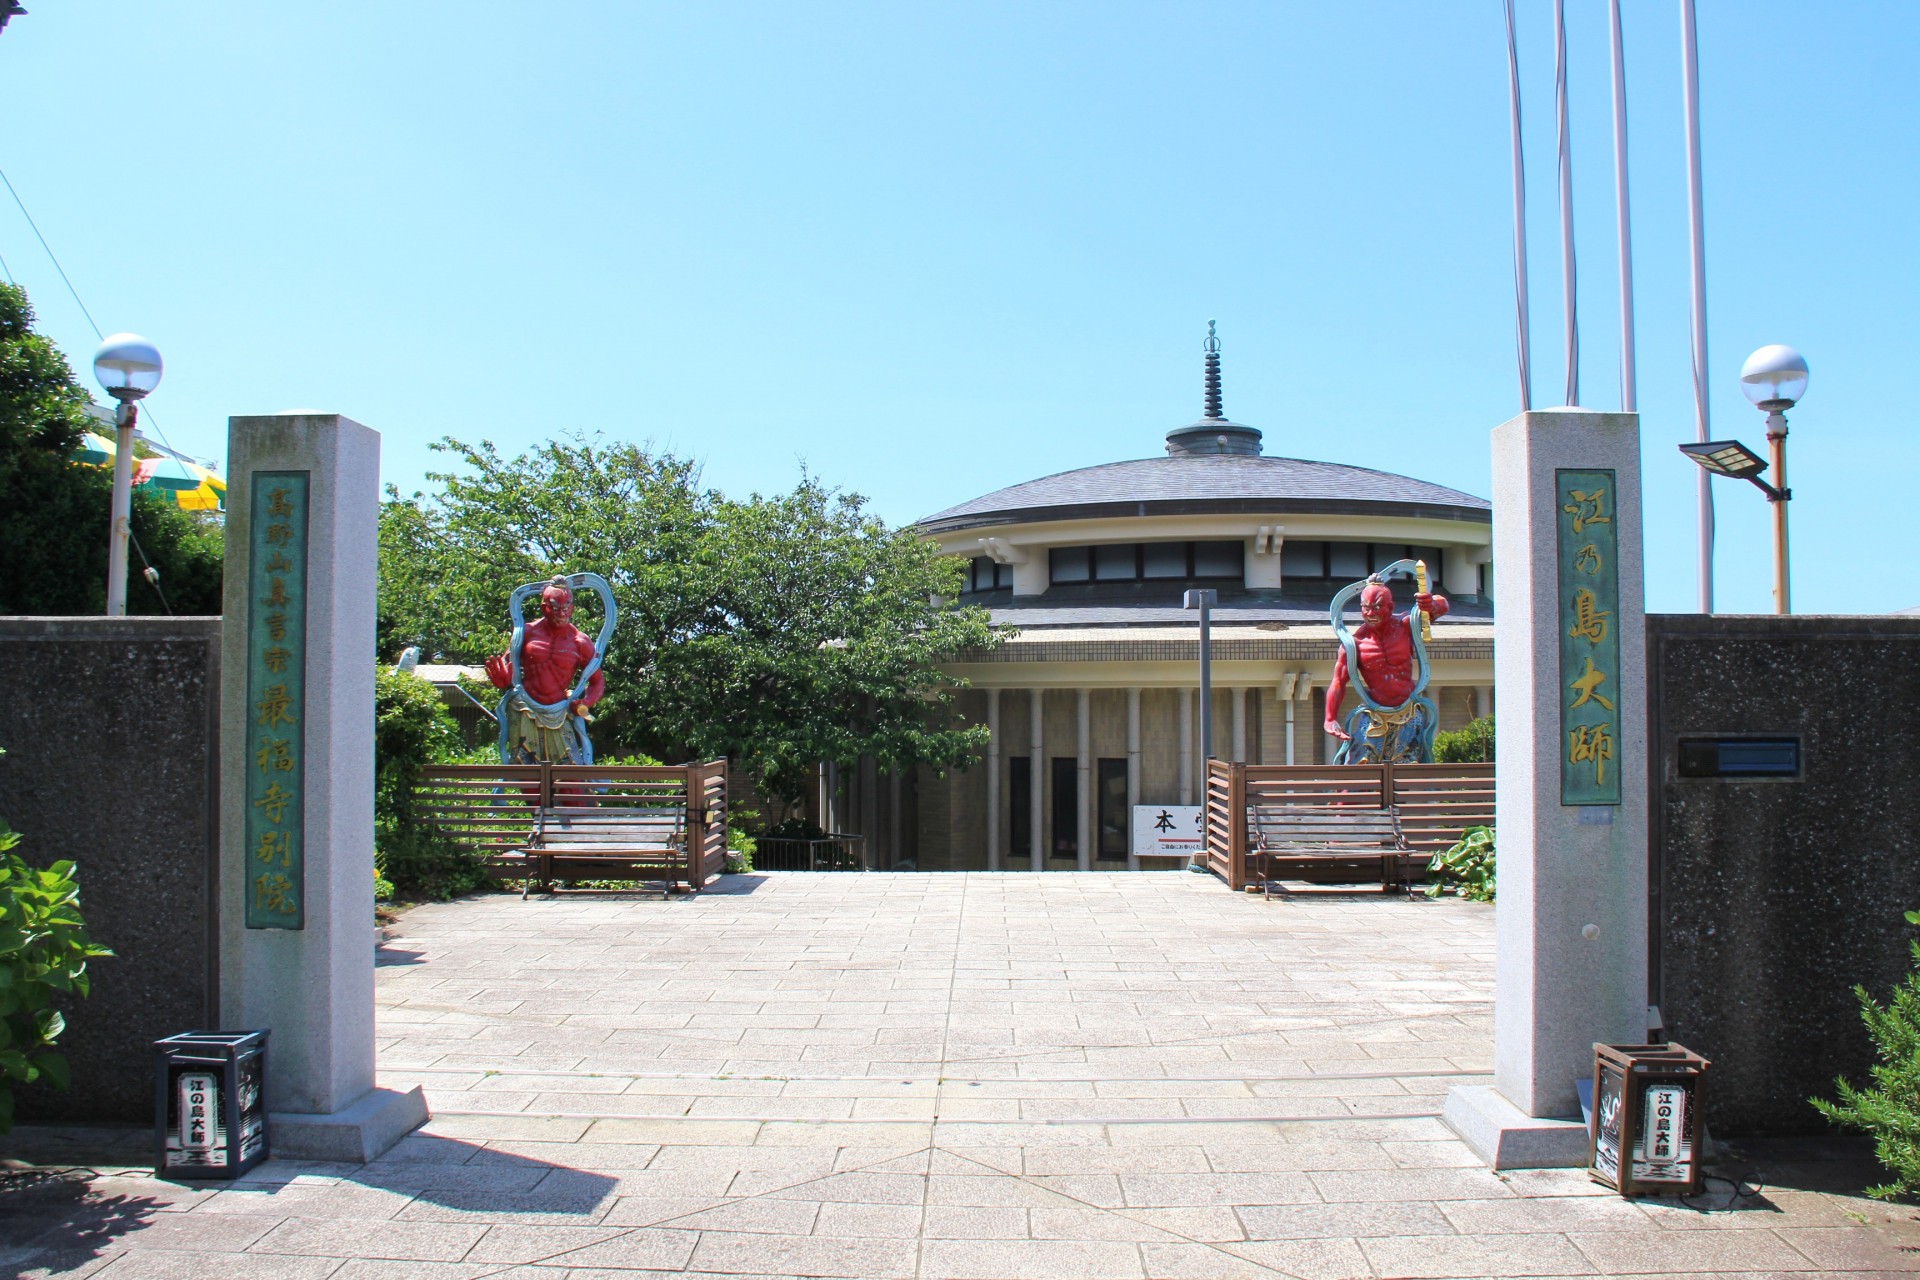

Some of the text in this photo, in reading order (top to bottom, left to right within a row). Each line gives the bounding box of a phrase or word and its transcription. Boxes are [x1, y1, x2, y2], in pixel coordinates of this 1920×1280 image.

[190, 1080, 205, 1143] 江の島大師
[1655, 1093, 1672, 1157] 江の島大師
